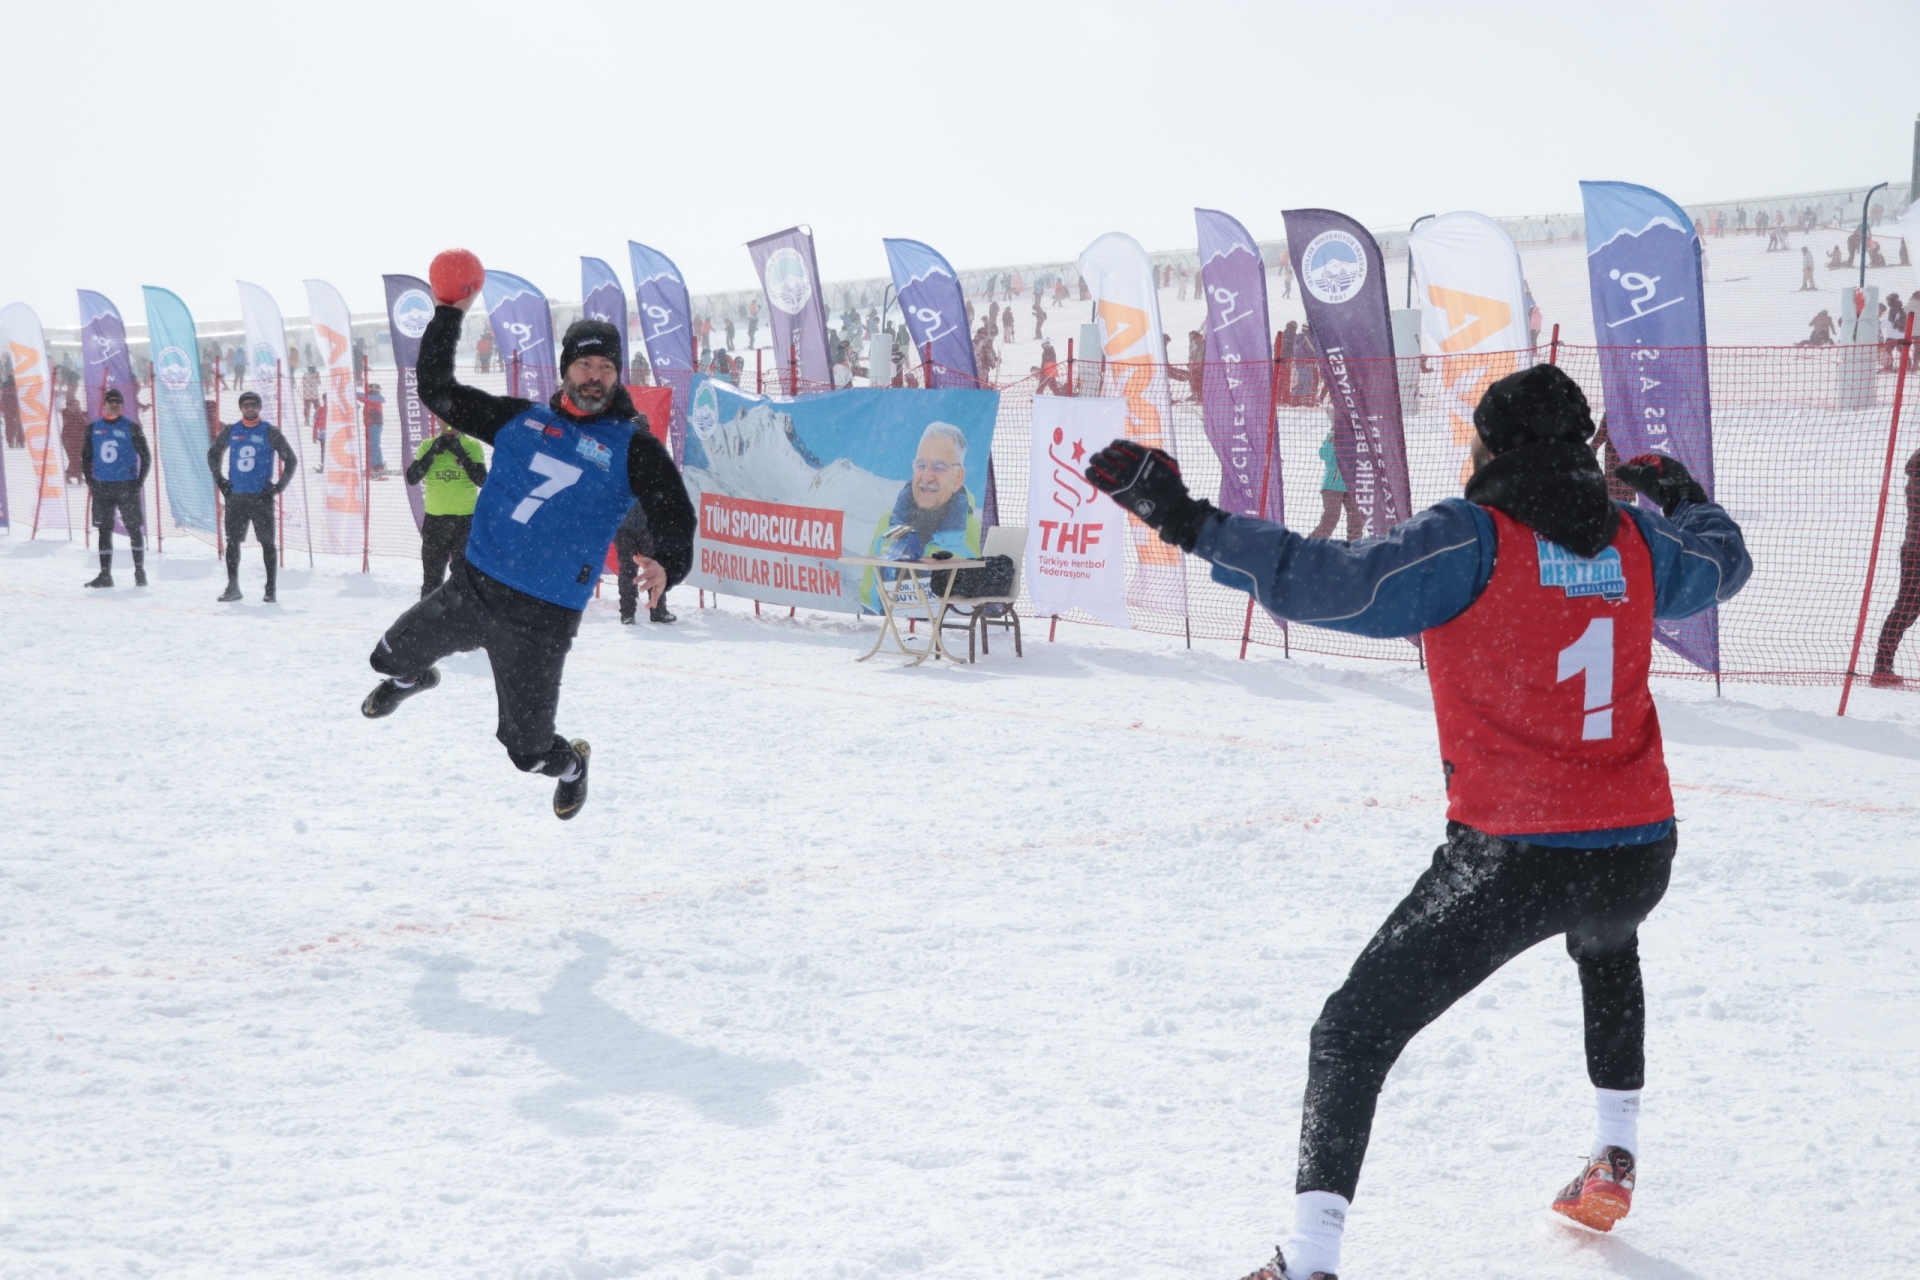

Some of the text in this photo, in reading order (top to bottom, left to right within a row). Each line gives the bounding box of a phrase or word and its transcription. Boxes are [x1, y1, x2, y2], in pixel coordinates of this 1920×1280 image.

[101, 440, 119, 464] 6
[237, 445, 256, 472] 8
[511, 452, 584, 525] 7
[704, 501, 836, 551] TÜM SPORCULARA
[1038, 520, 1104, 555] THF
[701, 548, 842, 597] BAŞARILAR DİLERİM
[1038, 555, 1106, 569] Türkiye Hentbol
[1039, 566, 1091, 580] Federasyonu
[1557, 617, 1614, 741] 1
